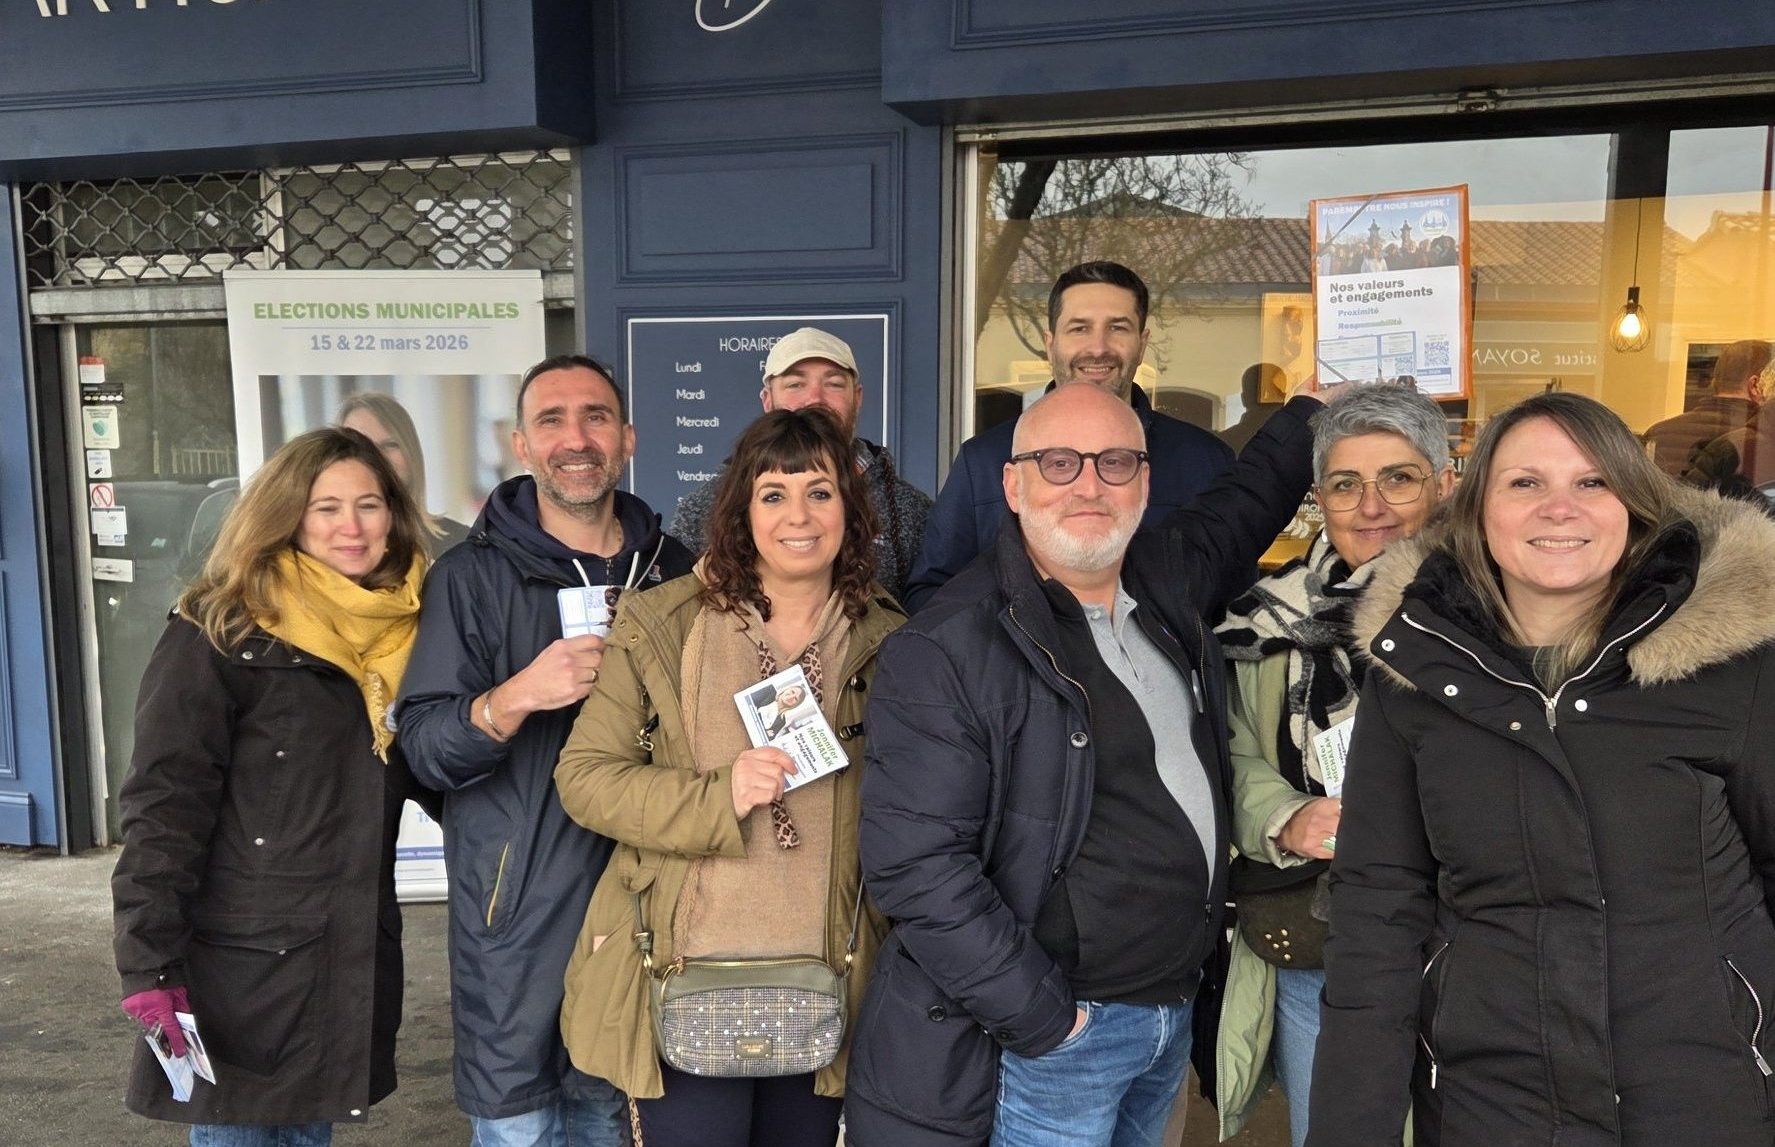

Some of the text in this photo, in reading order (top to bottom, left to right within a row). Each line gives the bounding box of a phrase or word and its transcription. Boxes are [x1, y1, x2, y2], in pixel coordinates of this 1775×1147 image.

[1322, 203, 1382, 215] PAREMPRE
[1330, 279, 1405, 293] Nos valeurs
[1329, 286, 1433, 304] et engagements
[253, 302, 520, 320] ELECTIONS MUNICIPALES
[1338, 318, 1402, 330] Respbilité
[311, 334, 469, 350] 15 & 22 mars 2026
[675, 361, 702, 373] Lundi
[676, 388, 705, 400] Mardi
[676, 416, 720, 428] Mercredi
[677, 443, 703, 455] Jeudi
[806, 726, 835, 768] MICHALAK
[816, 728, 839, 759] Jennifer
[1323, 735, 1340, 783] MICHALAK
